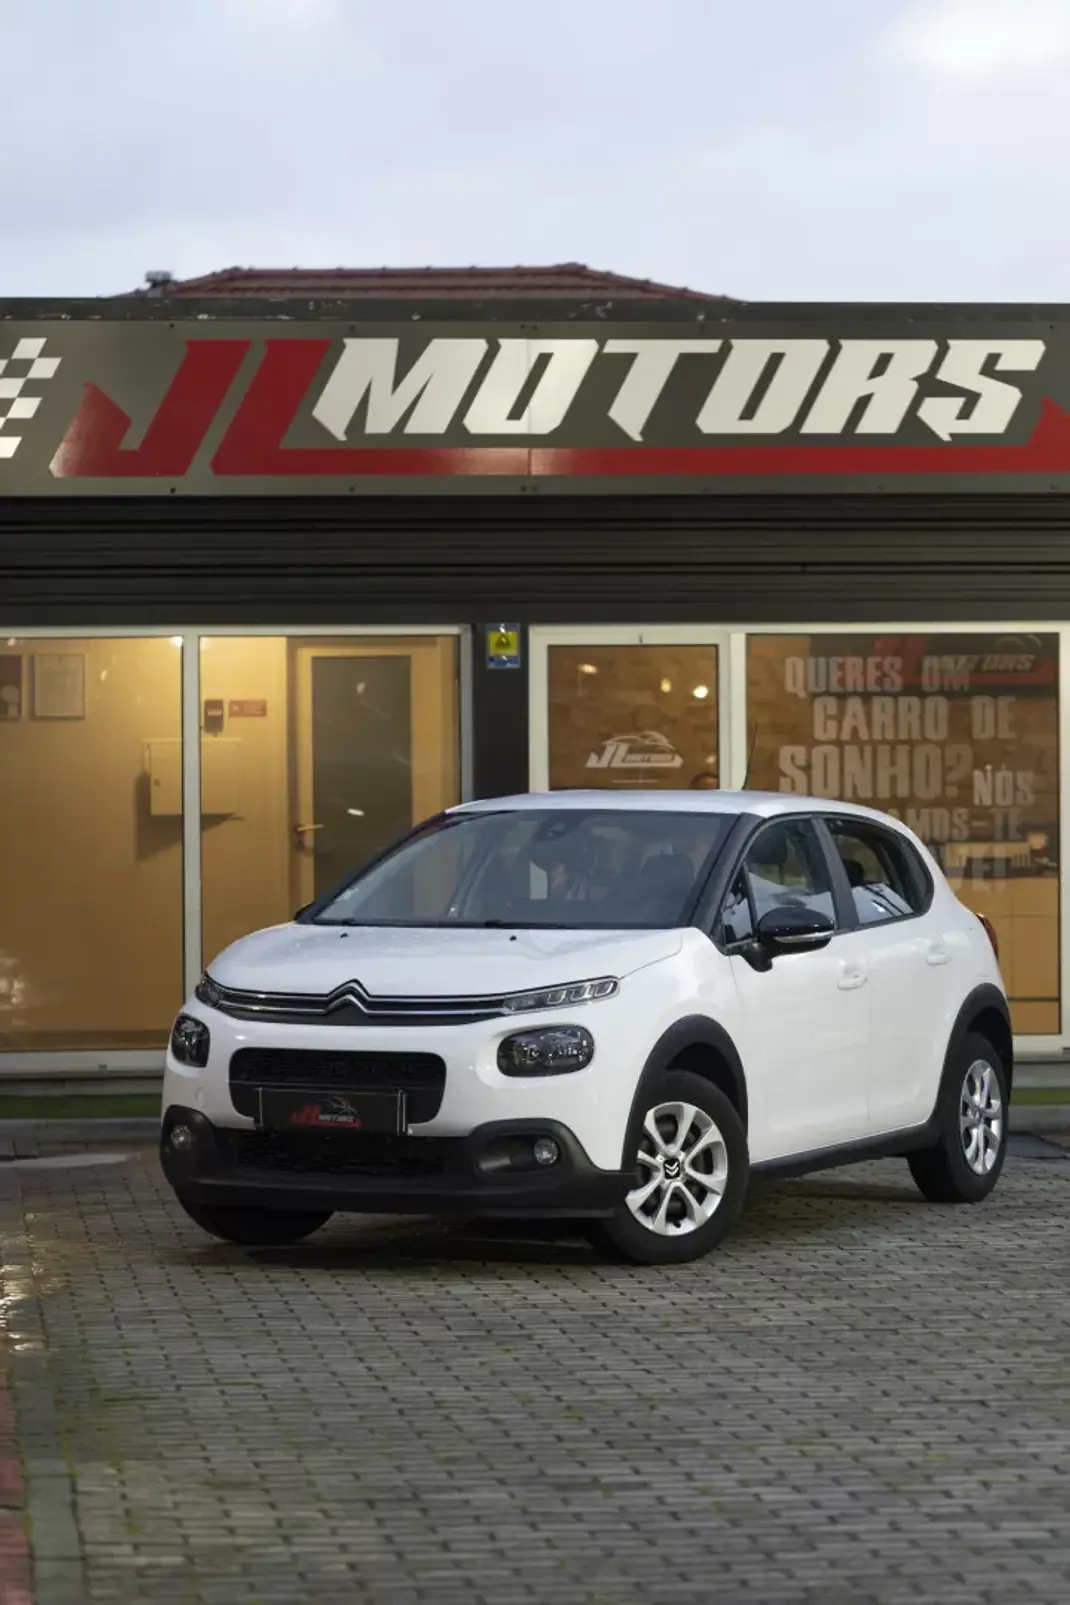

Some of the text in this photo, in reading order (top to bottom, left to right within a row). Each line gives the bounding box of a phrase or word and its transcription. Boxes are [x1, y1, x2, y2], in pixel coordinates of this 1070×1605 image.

[311, 337, 1046, 441] MOTORS
[784, 655, 904, 698] QUERES
[812, 695, 1018, 741] CARRO DE
[778, 743, 974, 800] SONHO?
